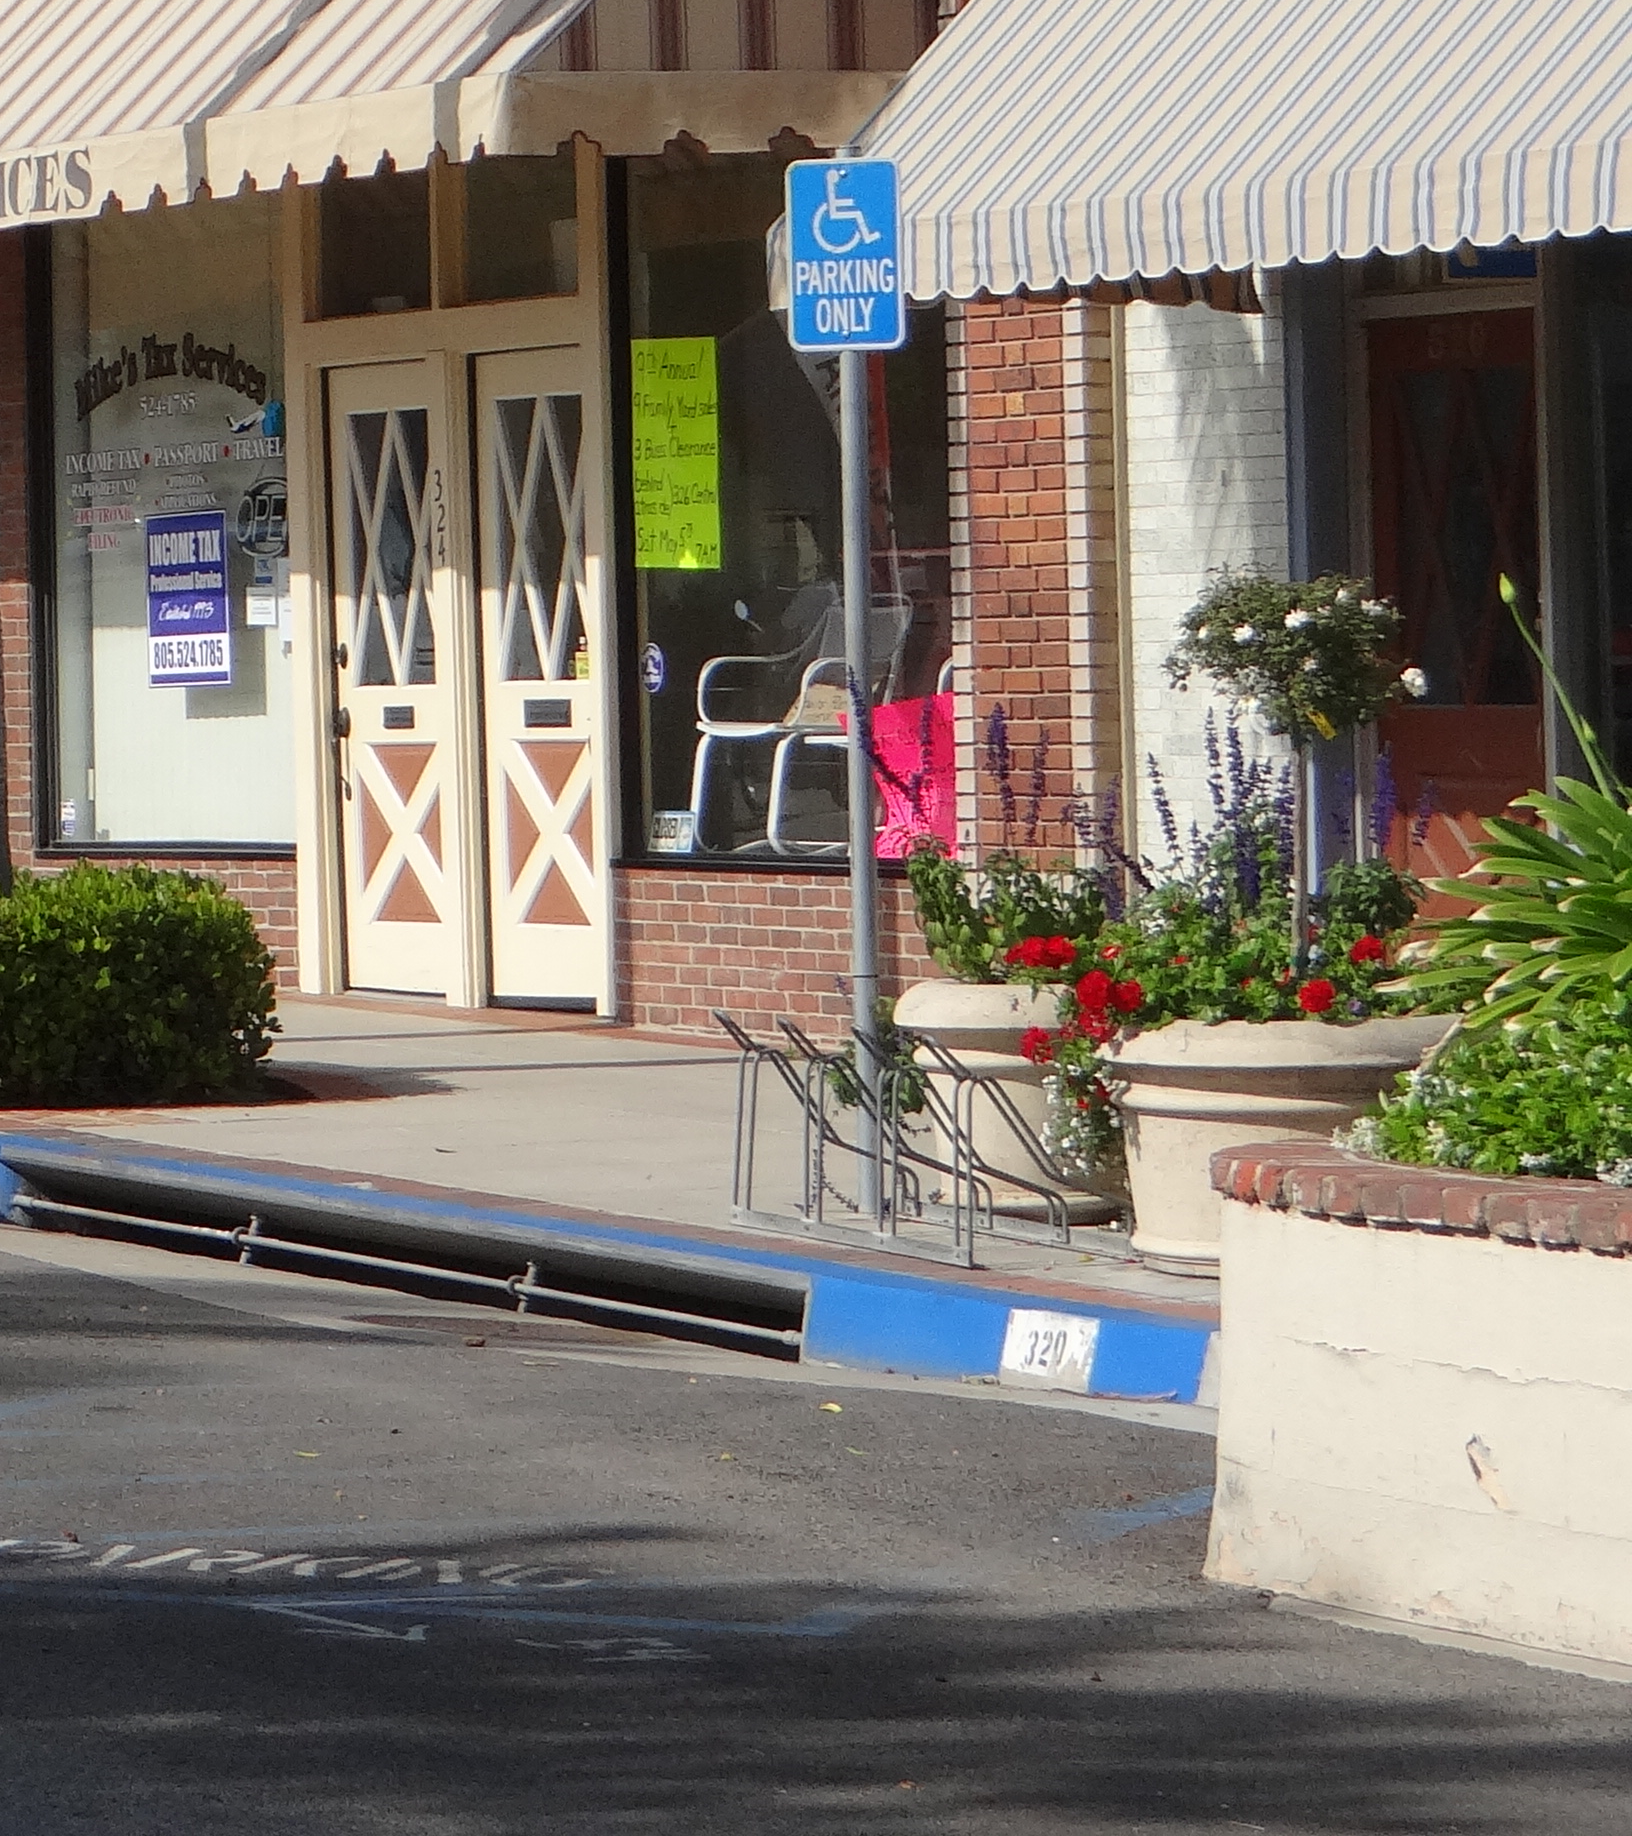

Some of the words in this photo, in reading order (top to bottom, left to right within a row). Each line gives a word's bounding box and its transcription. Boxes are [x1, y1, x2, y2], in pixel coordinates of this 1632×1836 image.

[795, 258, 895, 296] PARKING
[816, 297, 875, 333] ONLY
[74, 345, 138, 422] Mike's
[141, 332, 177, 380] Tax
[182, 332, 267, 405] Services
[66, 451, 114, 475] INCOME
[118, 447, 141, 470] TAX
[154, 441, 219, 468] PASSPORT
[234, 436, 284, 461] TRAVEL
[236, 495, 288, 543] OPE
[434, 470, 446, 567] 324
[149, 532, 196, 566] INCOME
[197, 529, 221, 562] TAX
[195, 570, 222, 590] Service
[154, 639, 223, 669] 805.524.1785
[1024, 1330, 1068, 1367] 320
